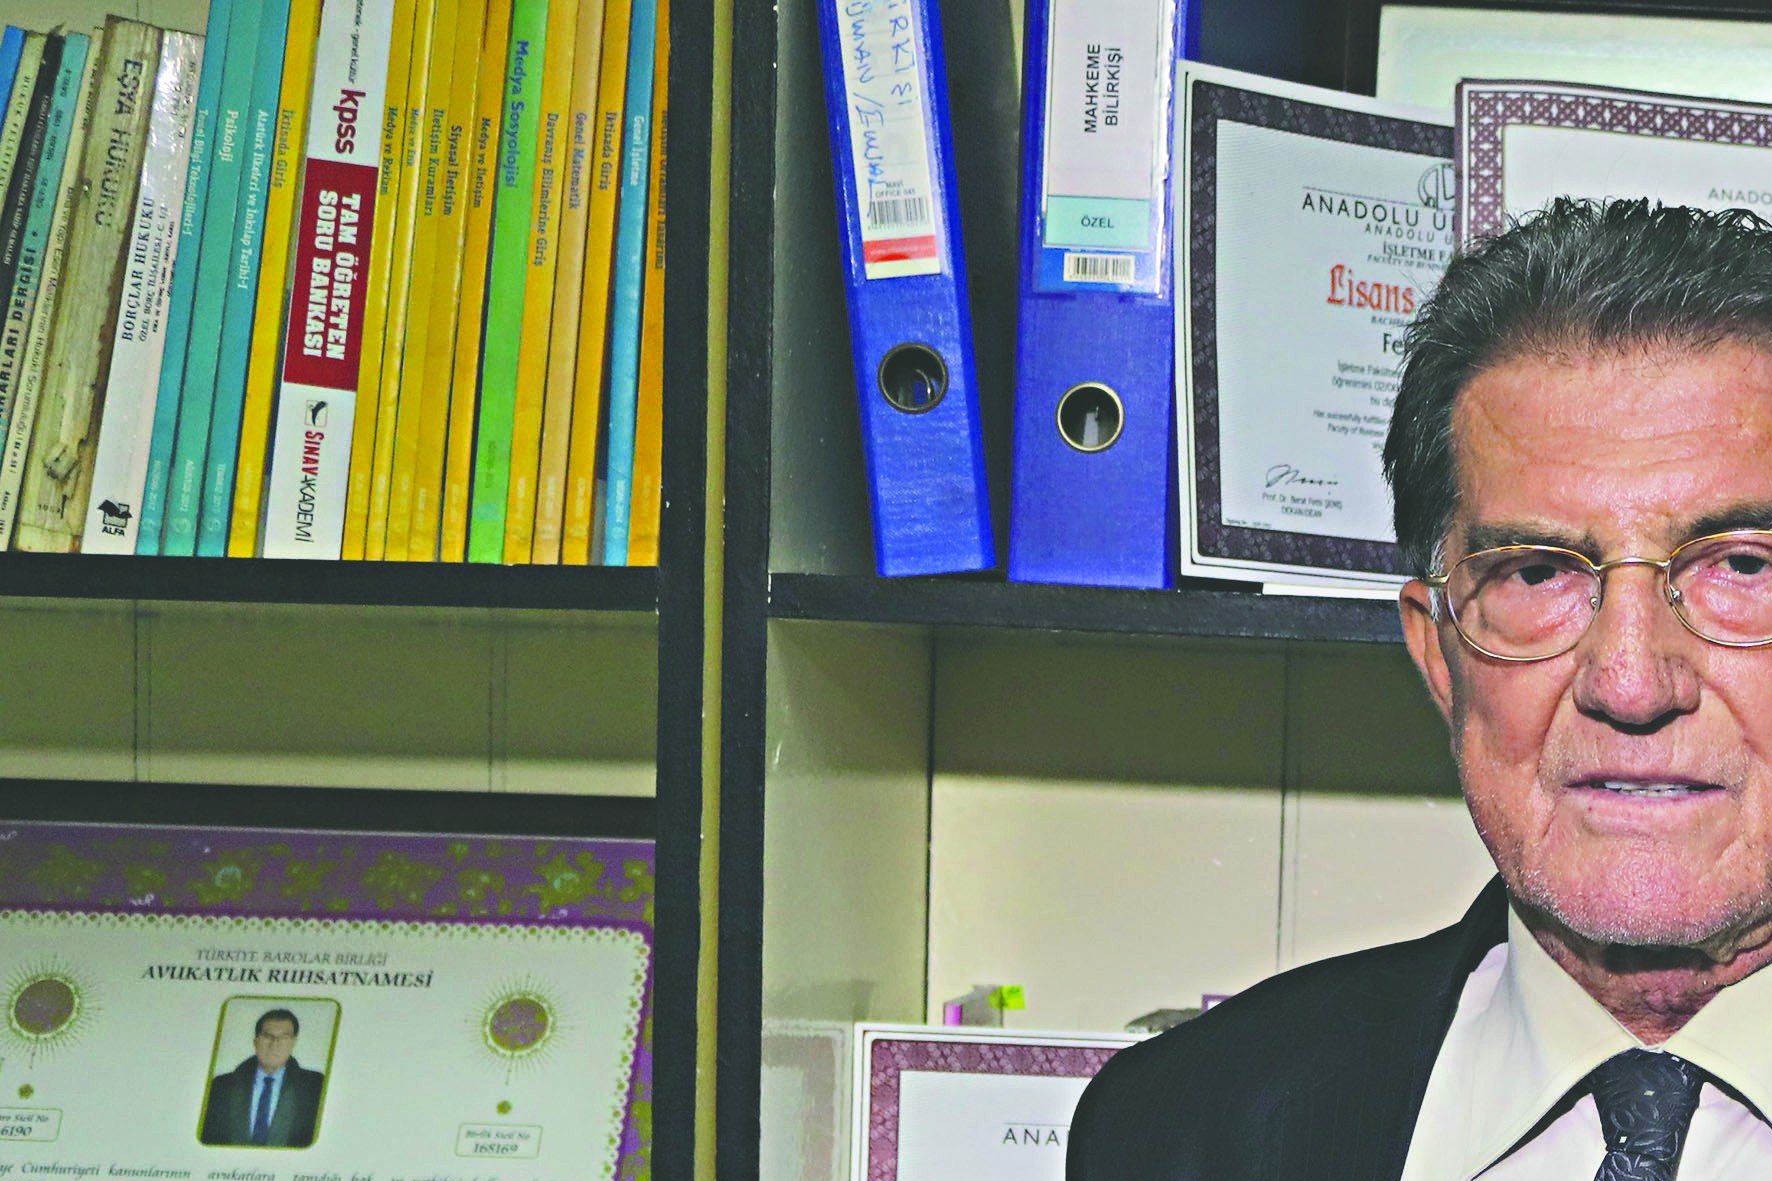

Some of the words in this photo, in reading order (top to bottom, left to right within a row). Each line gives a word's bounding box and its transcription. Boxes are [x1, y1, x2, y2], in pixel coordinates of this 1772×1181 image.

[115, 59, 143, 115] EŞYA
[511, 40, 529, 96] Medya
[1084, 44, 1101, 133] MAHKEME
[1103, 48, 1123, 126] BİLİRKİŞİ
[220, 109, 239, 163] Psikoloji
[253, 109, 269, 153] Atatürk
[333, 89, 366, 154] kpss
[447, 125, 462, 169] Siyasal
[478, 117, 491, 148] Medya
[504, 102, 525, 188] Sosyolojisi
[574, 112, 587, 147] Genel
[479, 151, 486, 165] ve
[569, 148, 585, 210] Matematik
[315, 190, 338, 251] SORU
[338, 193, 361, 245] TAM
[1081, 215, 1114, 228] ÖZEL
[1302, 193, 1419, 227] ANADOLU
[1365, 223, 1435, 243] ANADOLU
[14, 248, 36, 322] DERGİSİ
[121, 268, 146, 341] BORÇLAR
[134, 197, 155, 265] HUKUKU
[1327, 264, 1415, 314] Lisans
[303, 256, 332, 358] BANKASI
[327, 252, 359, 361] ÖĞRETEN
[102, 527, 125, 536] ALFA
[141, 964, 262, 983] AVUKATLIK
[268, 969, 434, 988] RUHSATNAMESİ
[197, 949, 259, 962] TÜRKİYE
[263, 951, 330, 965] BAROLAR
